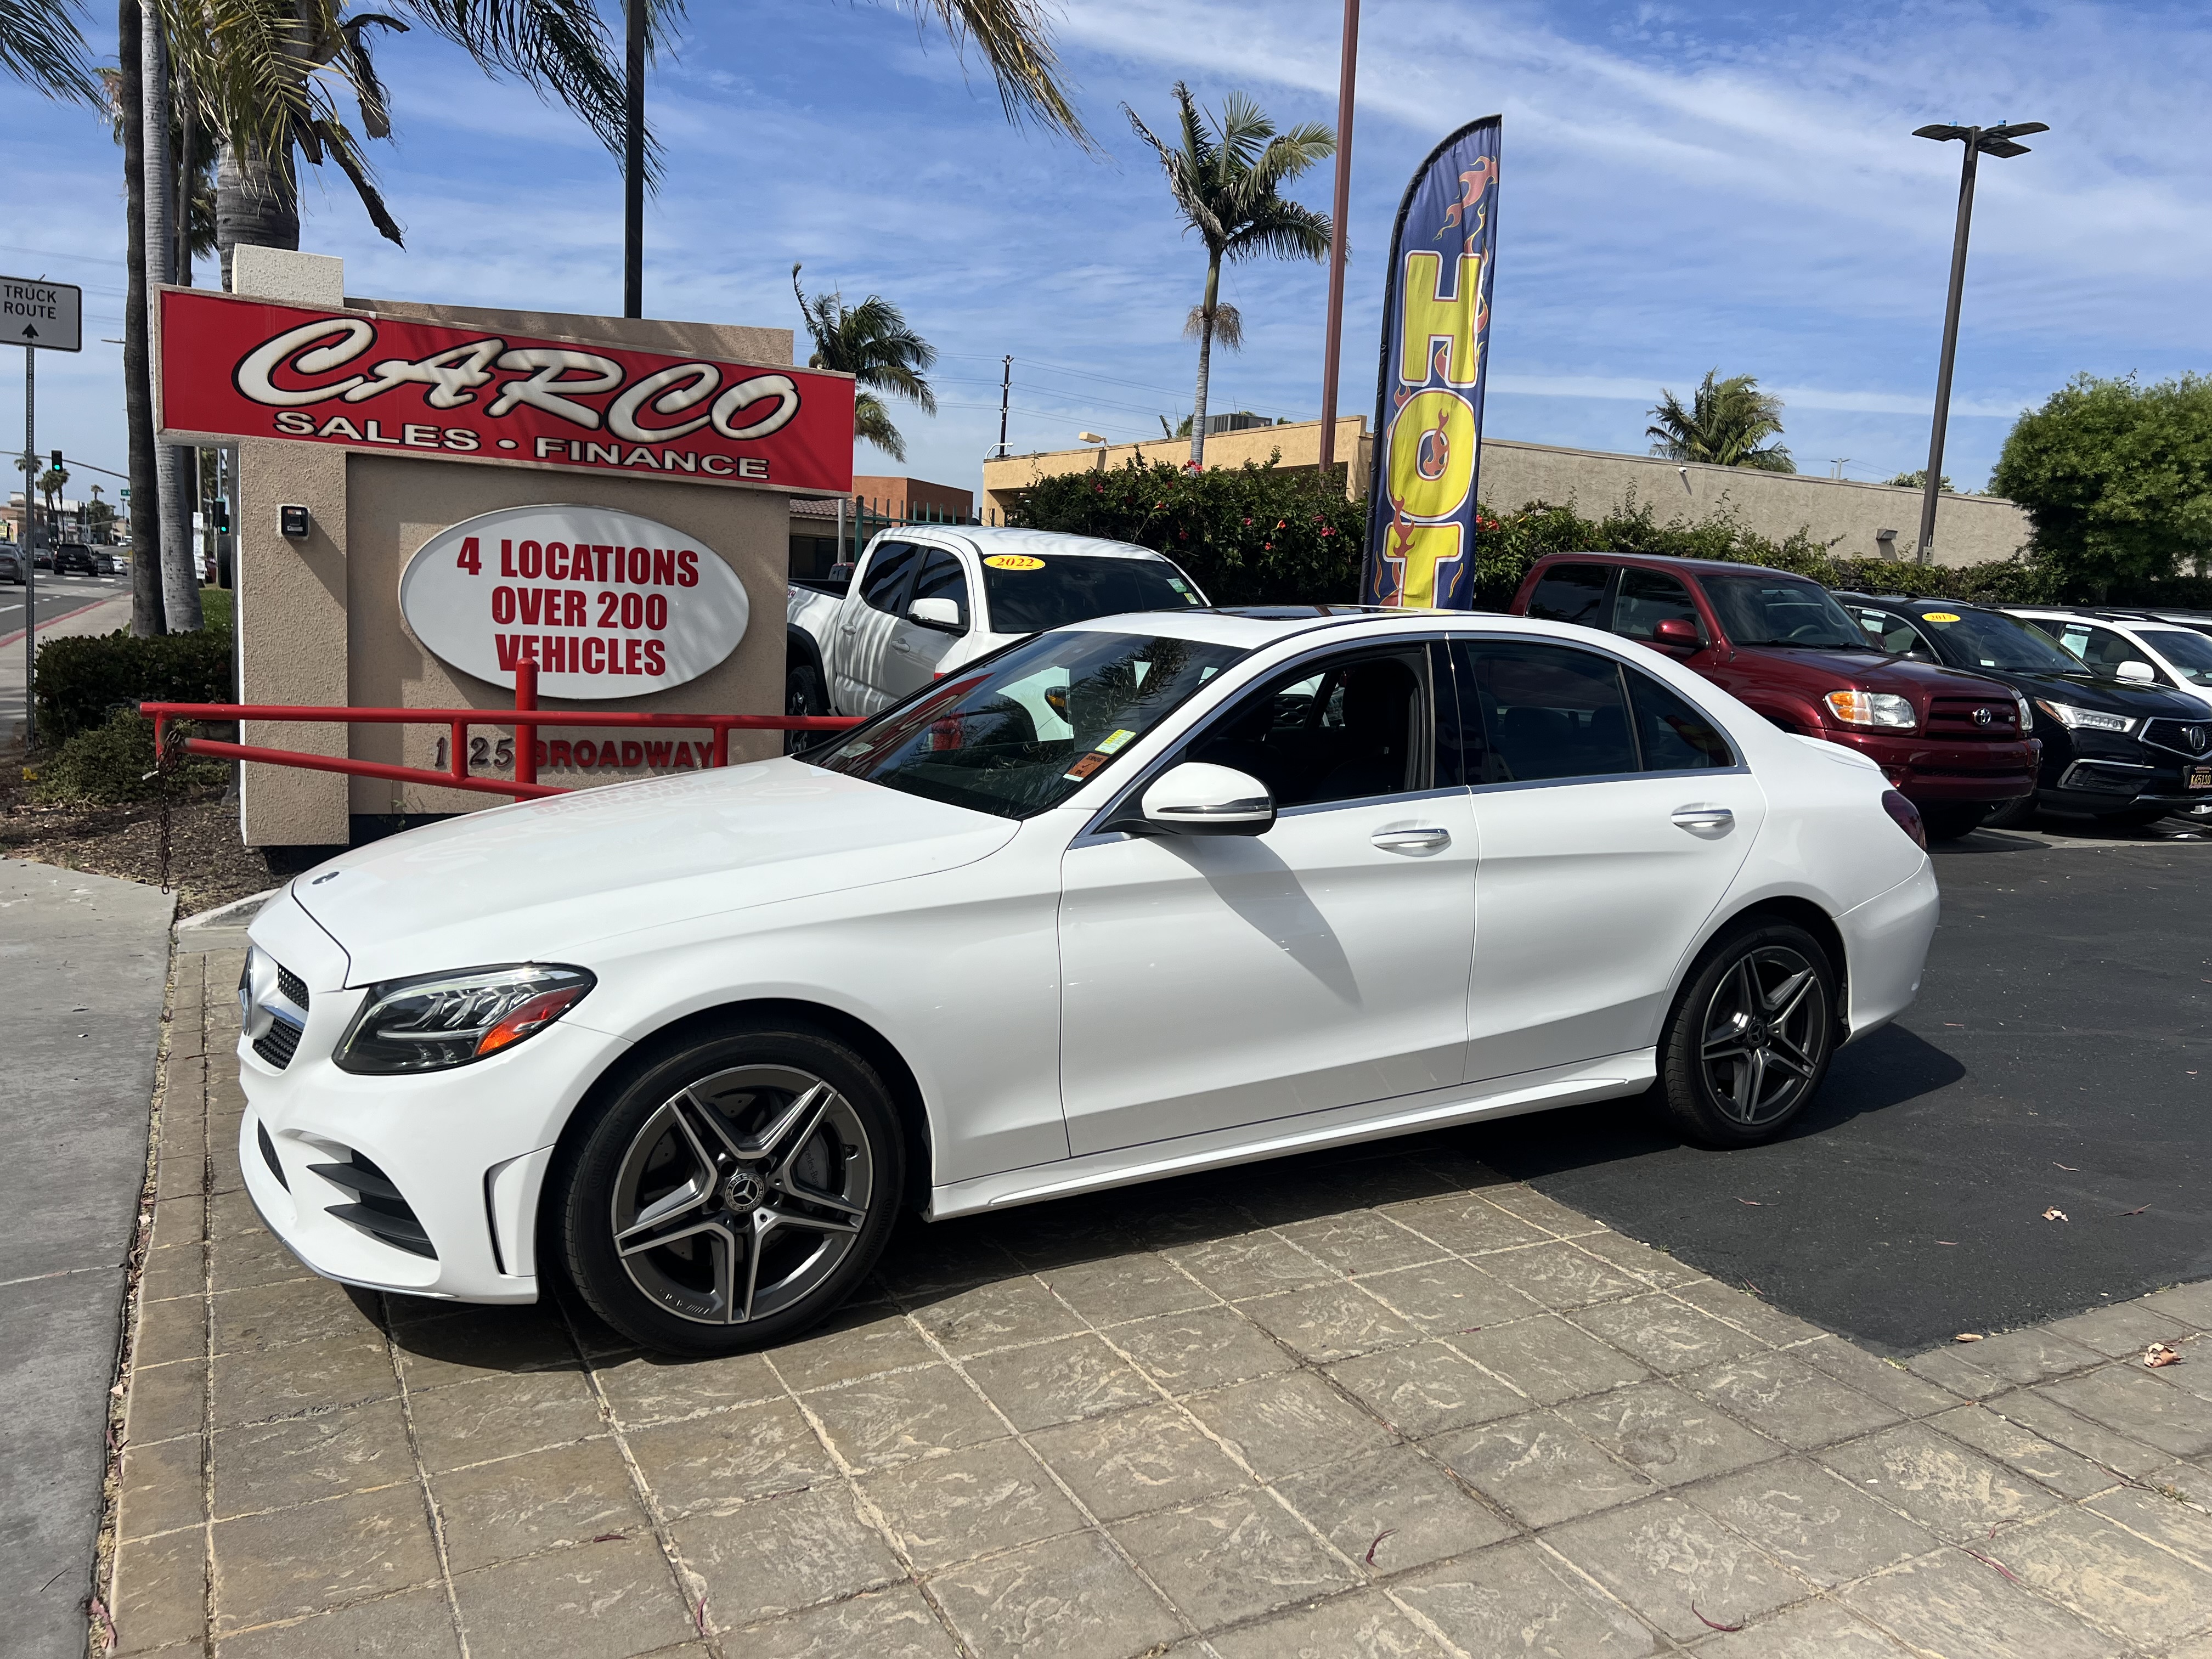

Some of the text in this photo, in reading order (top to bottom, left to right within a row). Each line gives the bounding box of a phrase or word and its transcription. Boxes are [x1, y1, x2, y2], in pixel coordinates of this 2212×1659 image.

[4, 284, 57, 303] TRUCK
[4, 301, 57, 319] ROUTE
[273, 410, 770, 480] SALES FINANCE
[1383, 250, 1485, 609] HOT
[456, 537, 699, 588] 4 LOCATIONS
[996, 557, 1034, 567] 2022
[492, 586, 668, 631] OVER 200
[494, 634, 666, 676] VEHICLES
[536, 739, 714, 768] BROADWAY
